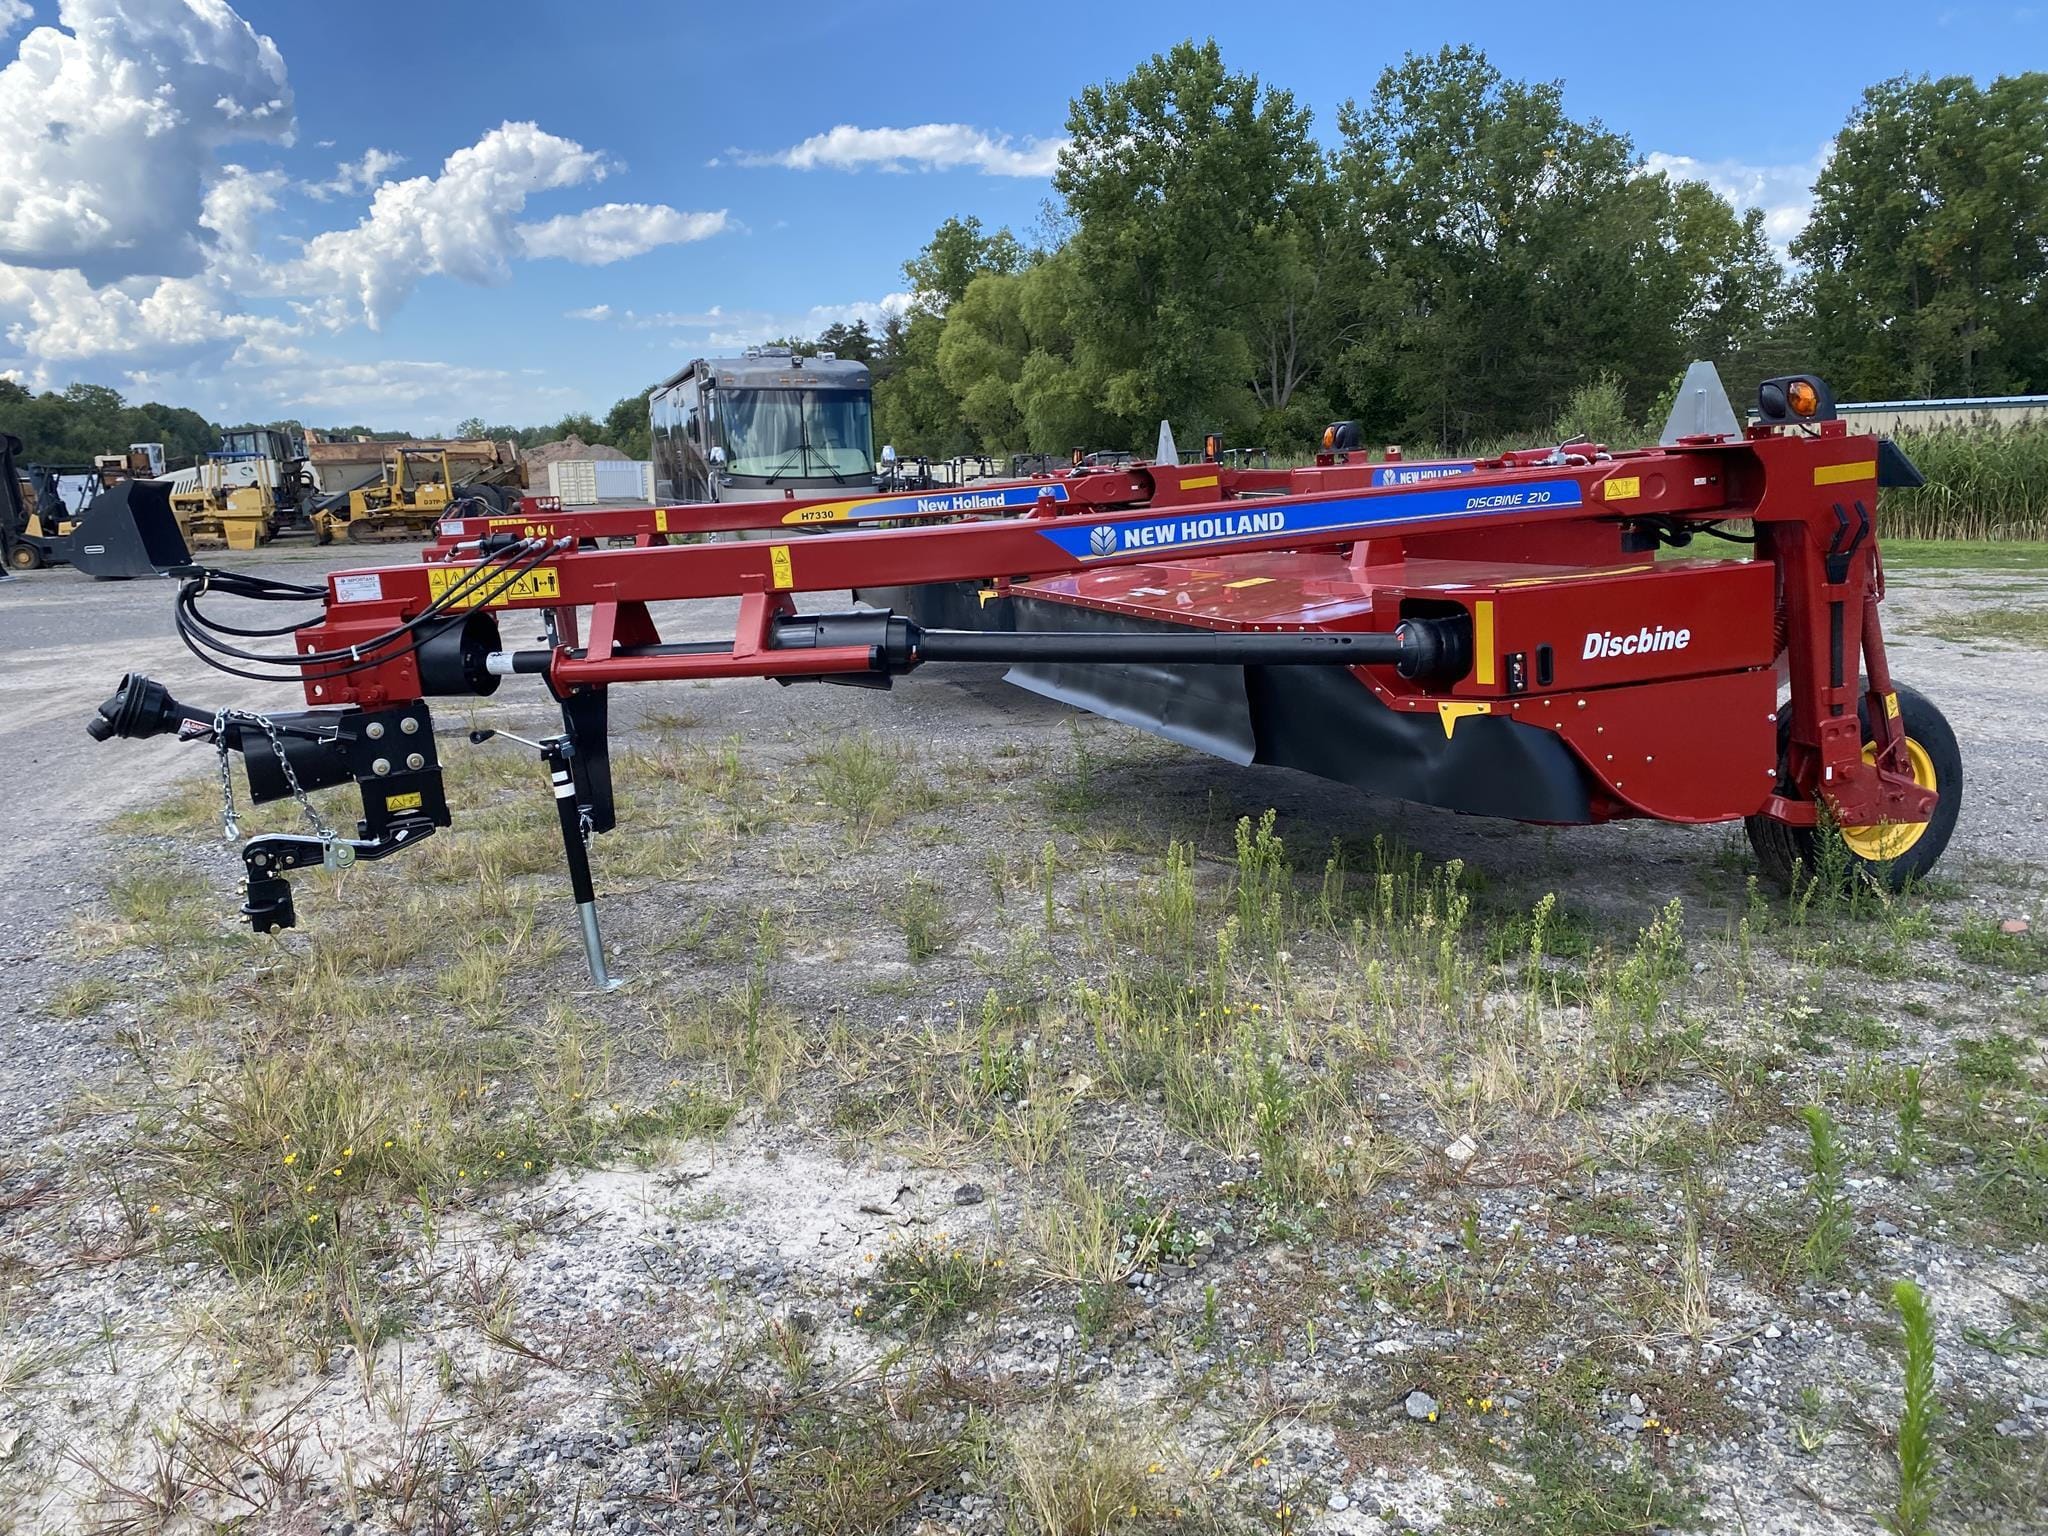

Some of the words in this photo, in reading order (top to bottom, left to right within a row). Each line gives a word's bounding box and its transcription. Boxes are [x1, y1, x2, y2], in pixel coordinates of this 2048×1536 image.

[1400, 471, 1419, 484] NEW
[801, 510, 834, 520] H7330
[917, 498, 951, 512] New
[952, 493, 1006, 510] Holland
[1466, 493, 1523, 509] DISCBINE
[1527, 491, 1551, 504] 210
[1124, 523, 1176, 548] NEW
[1181, 511, 1285, 541] HOLLAND
[1582, 625, 1691, 660] Discbine
